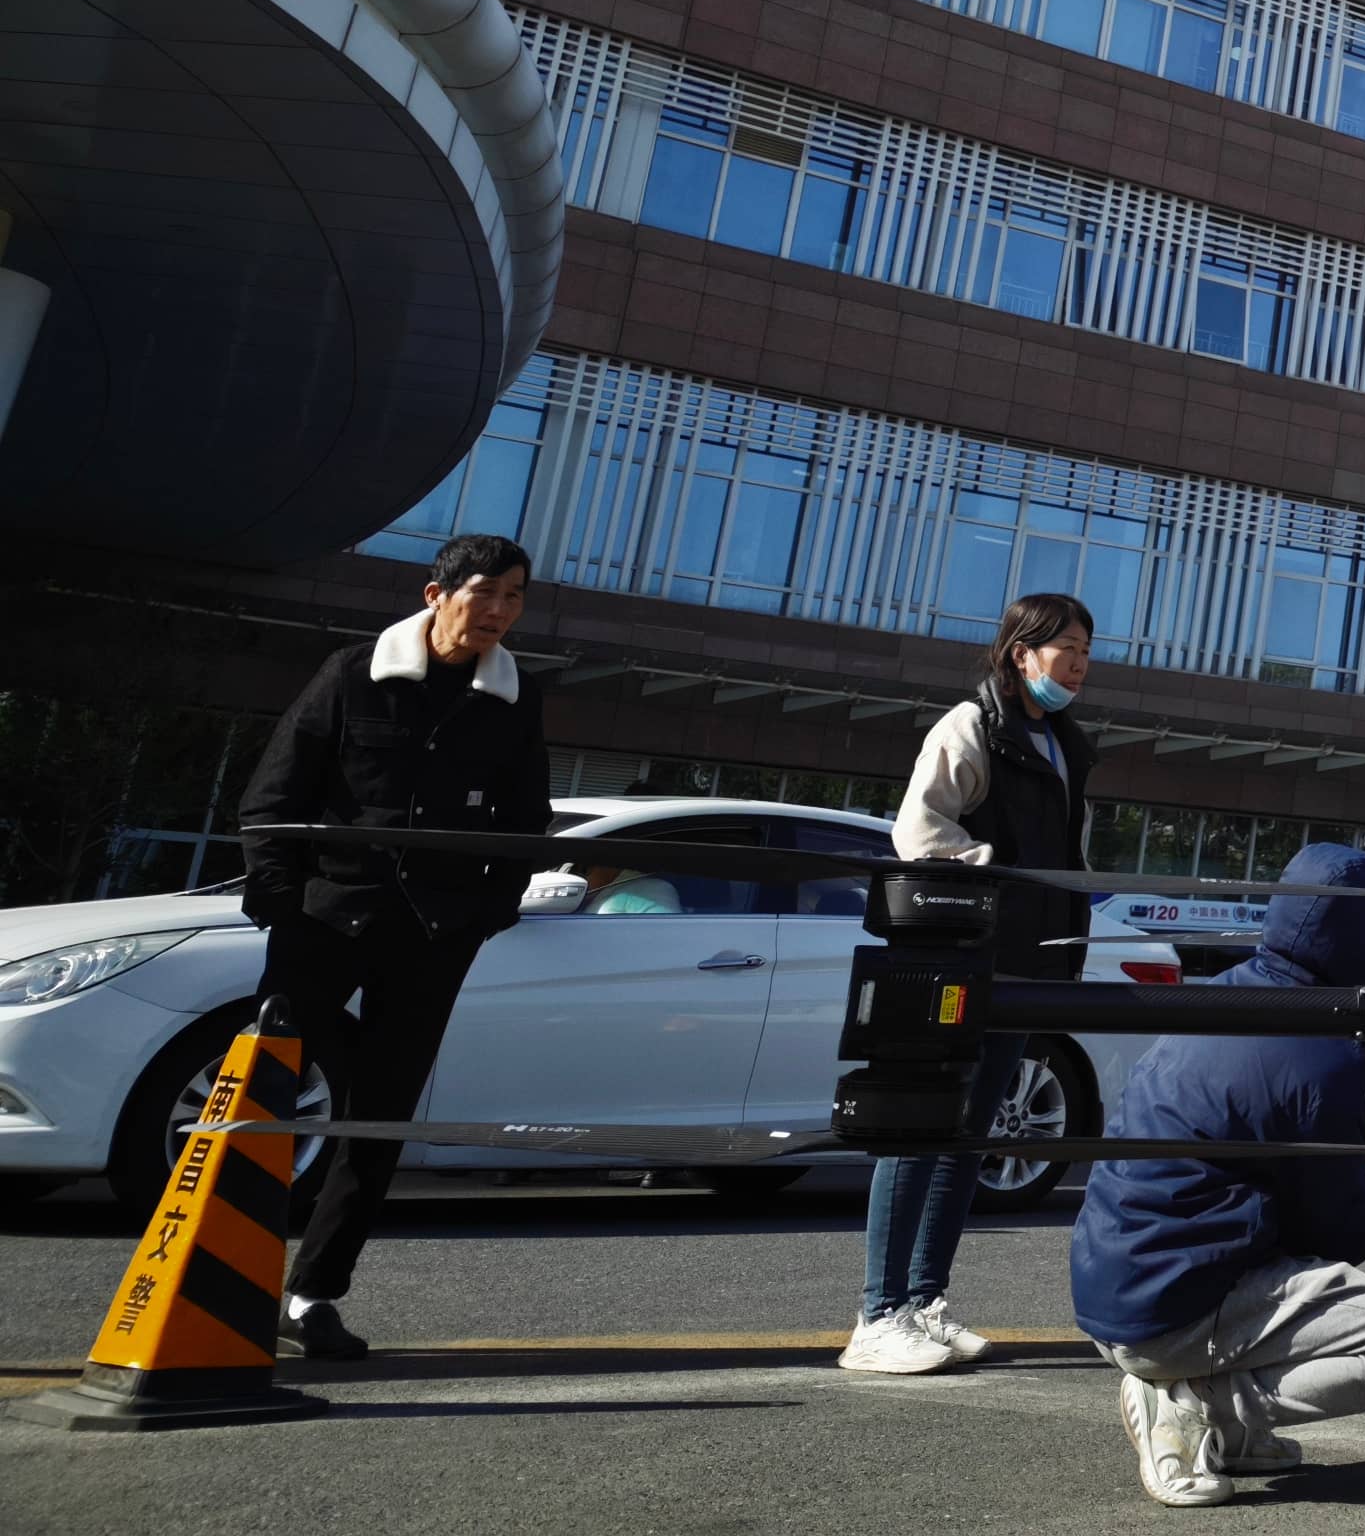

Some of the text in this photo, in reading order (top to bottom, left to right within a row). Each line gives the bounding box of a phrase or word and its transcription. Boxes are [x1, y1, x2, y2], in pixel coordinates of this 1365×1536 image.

[1147, 904, 1179, 921] 120
[115, 1070, 243, 1336] 南昌交警
